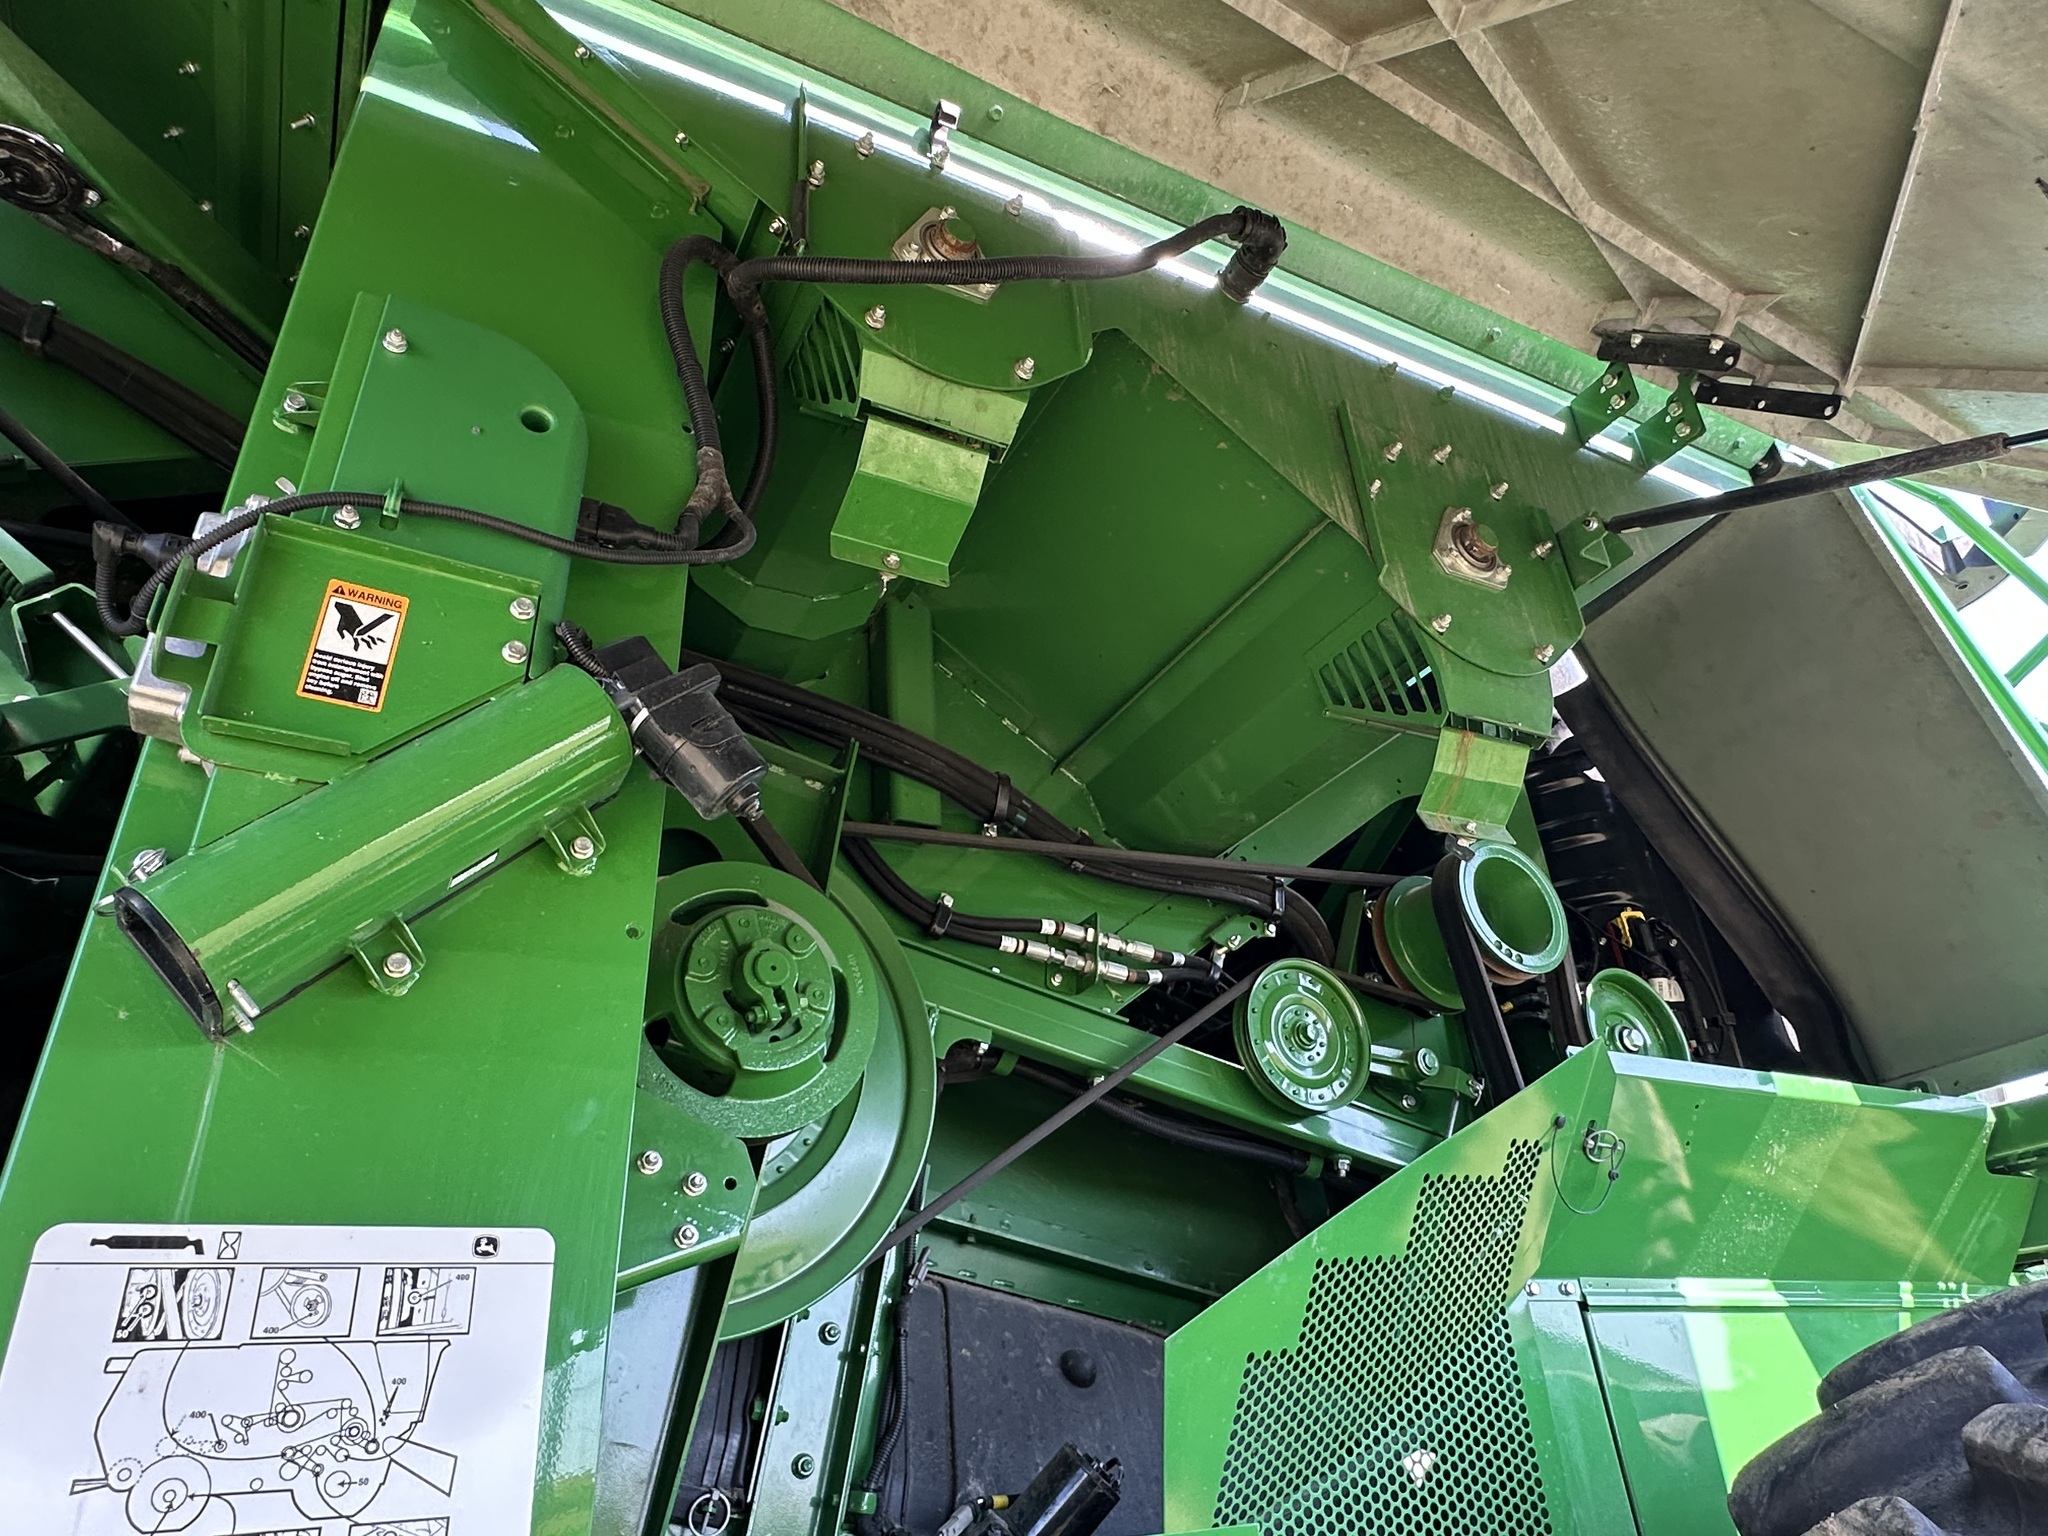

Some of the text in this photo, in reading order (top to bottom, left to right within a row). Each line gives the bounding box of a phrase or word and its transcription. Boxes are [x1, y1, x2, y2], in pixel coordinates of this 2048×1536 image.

[348, 588, 403, 609] WARNING
[357, 661, 376, 672] injury
[340, 678, 354, 686] and
[455, 1273, 471, 1281] 400
[262, 1326, 280, 1334] 400
[391, 1376, 407, 1386] 400
[189, 1410, 207, 1420] 400
[357, 1477, 370, 1486] 50
